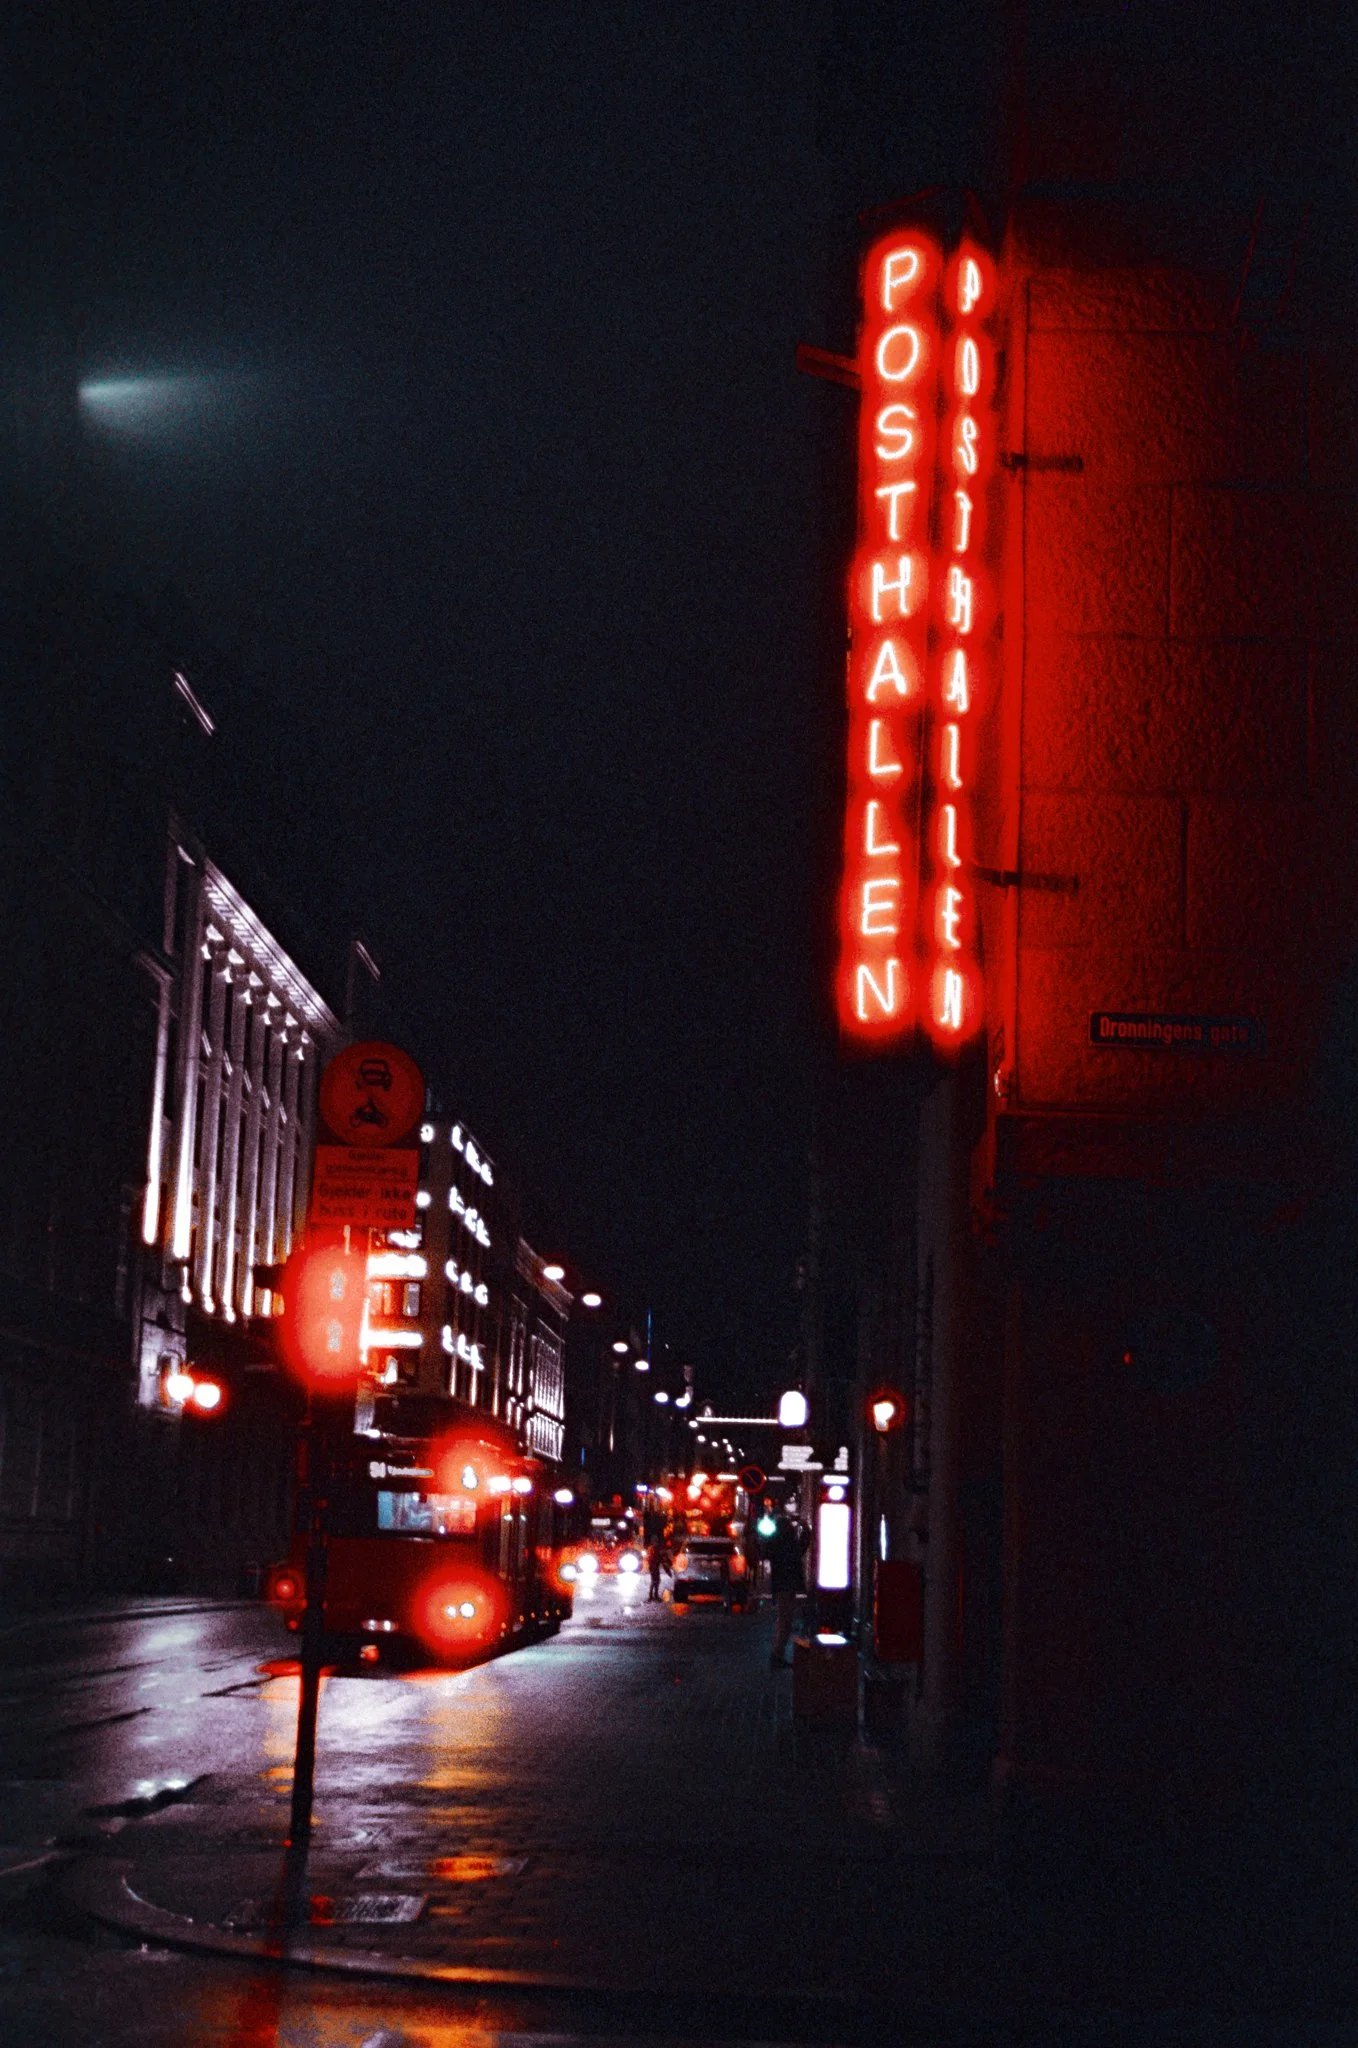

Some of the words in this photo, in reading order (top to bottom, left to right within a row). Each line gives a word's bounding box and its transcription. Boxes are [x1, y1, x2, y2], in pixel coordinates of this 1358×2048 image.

[857, 248, 918, 1020] POSTHALLEN
[940, 257, 980, 1029] POSTHALLEN
[1099, 1016, 1202, 1045] Dronningens
